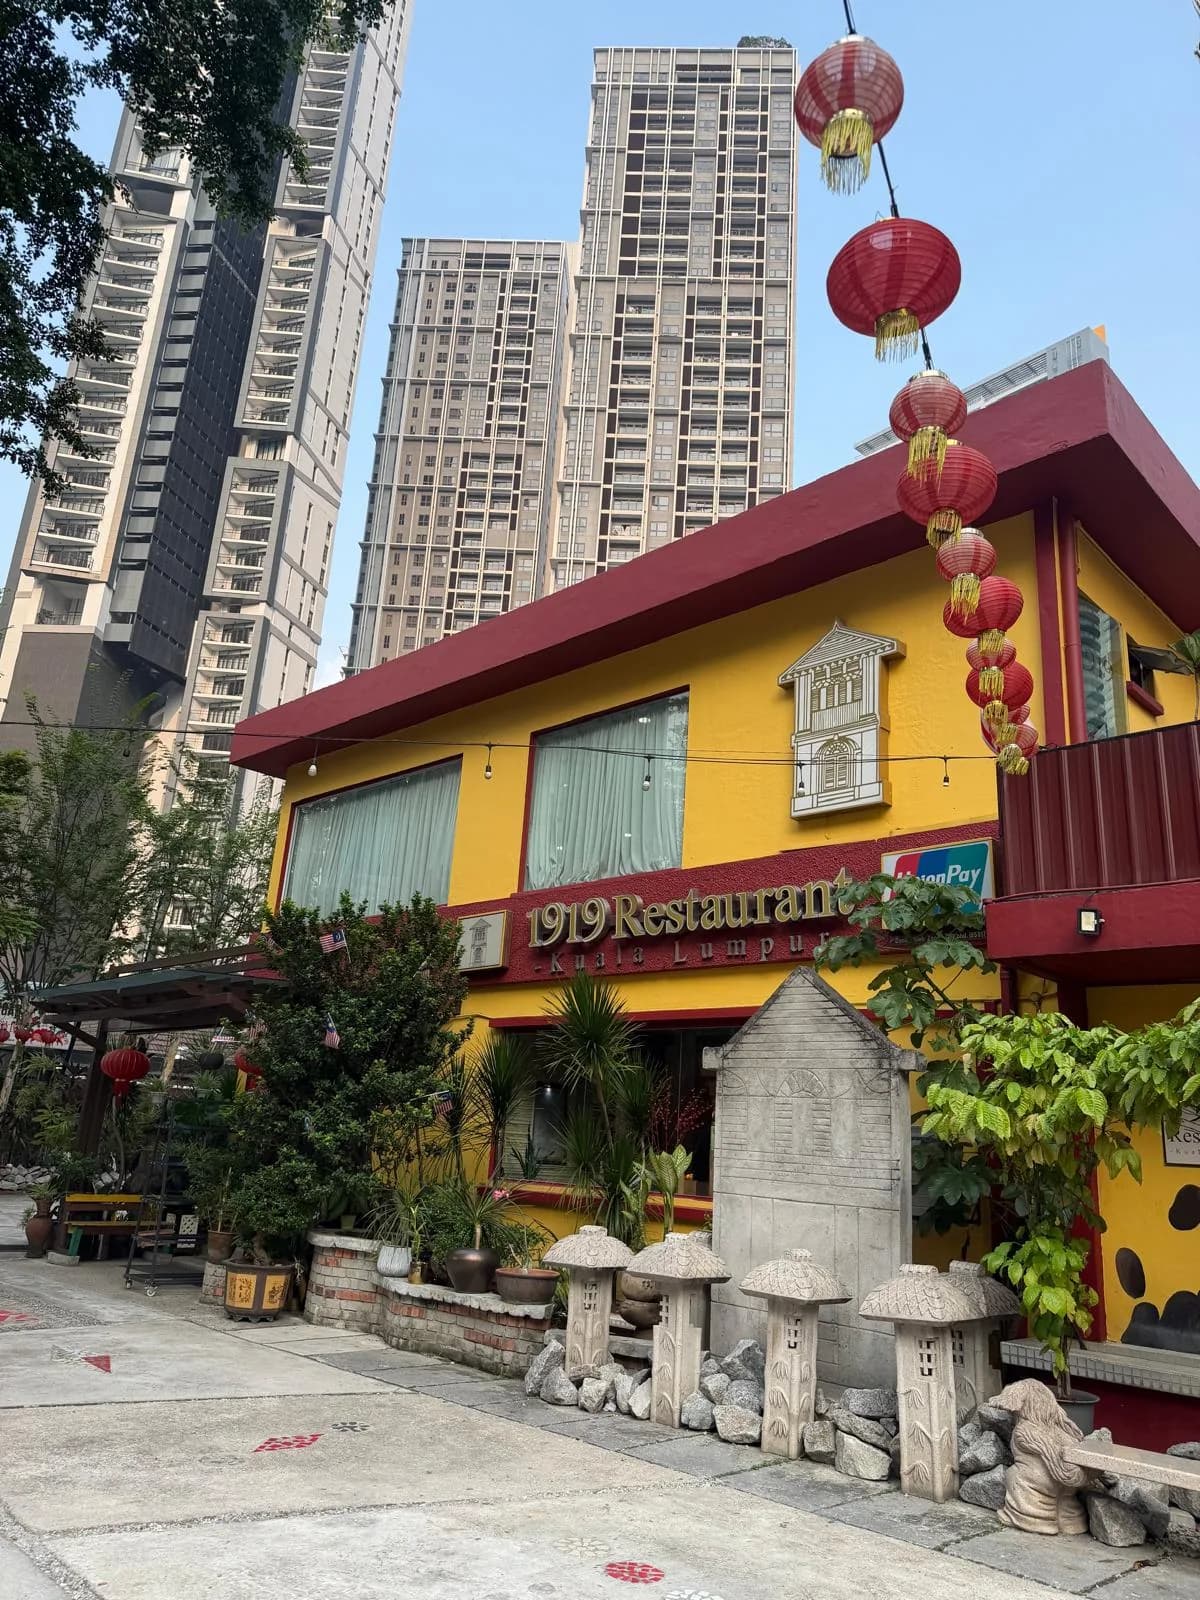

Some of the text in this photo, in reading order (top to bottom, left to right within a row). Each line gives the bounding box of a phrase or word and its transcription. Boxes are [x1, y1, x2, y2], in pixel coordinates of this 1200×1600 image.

[527, 866, 856, 947] 1919 Restaurant
[673, 931, 830, 963] Lumpur
